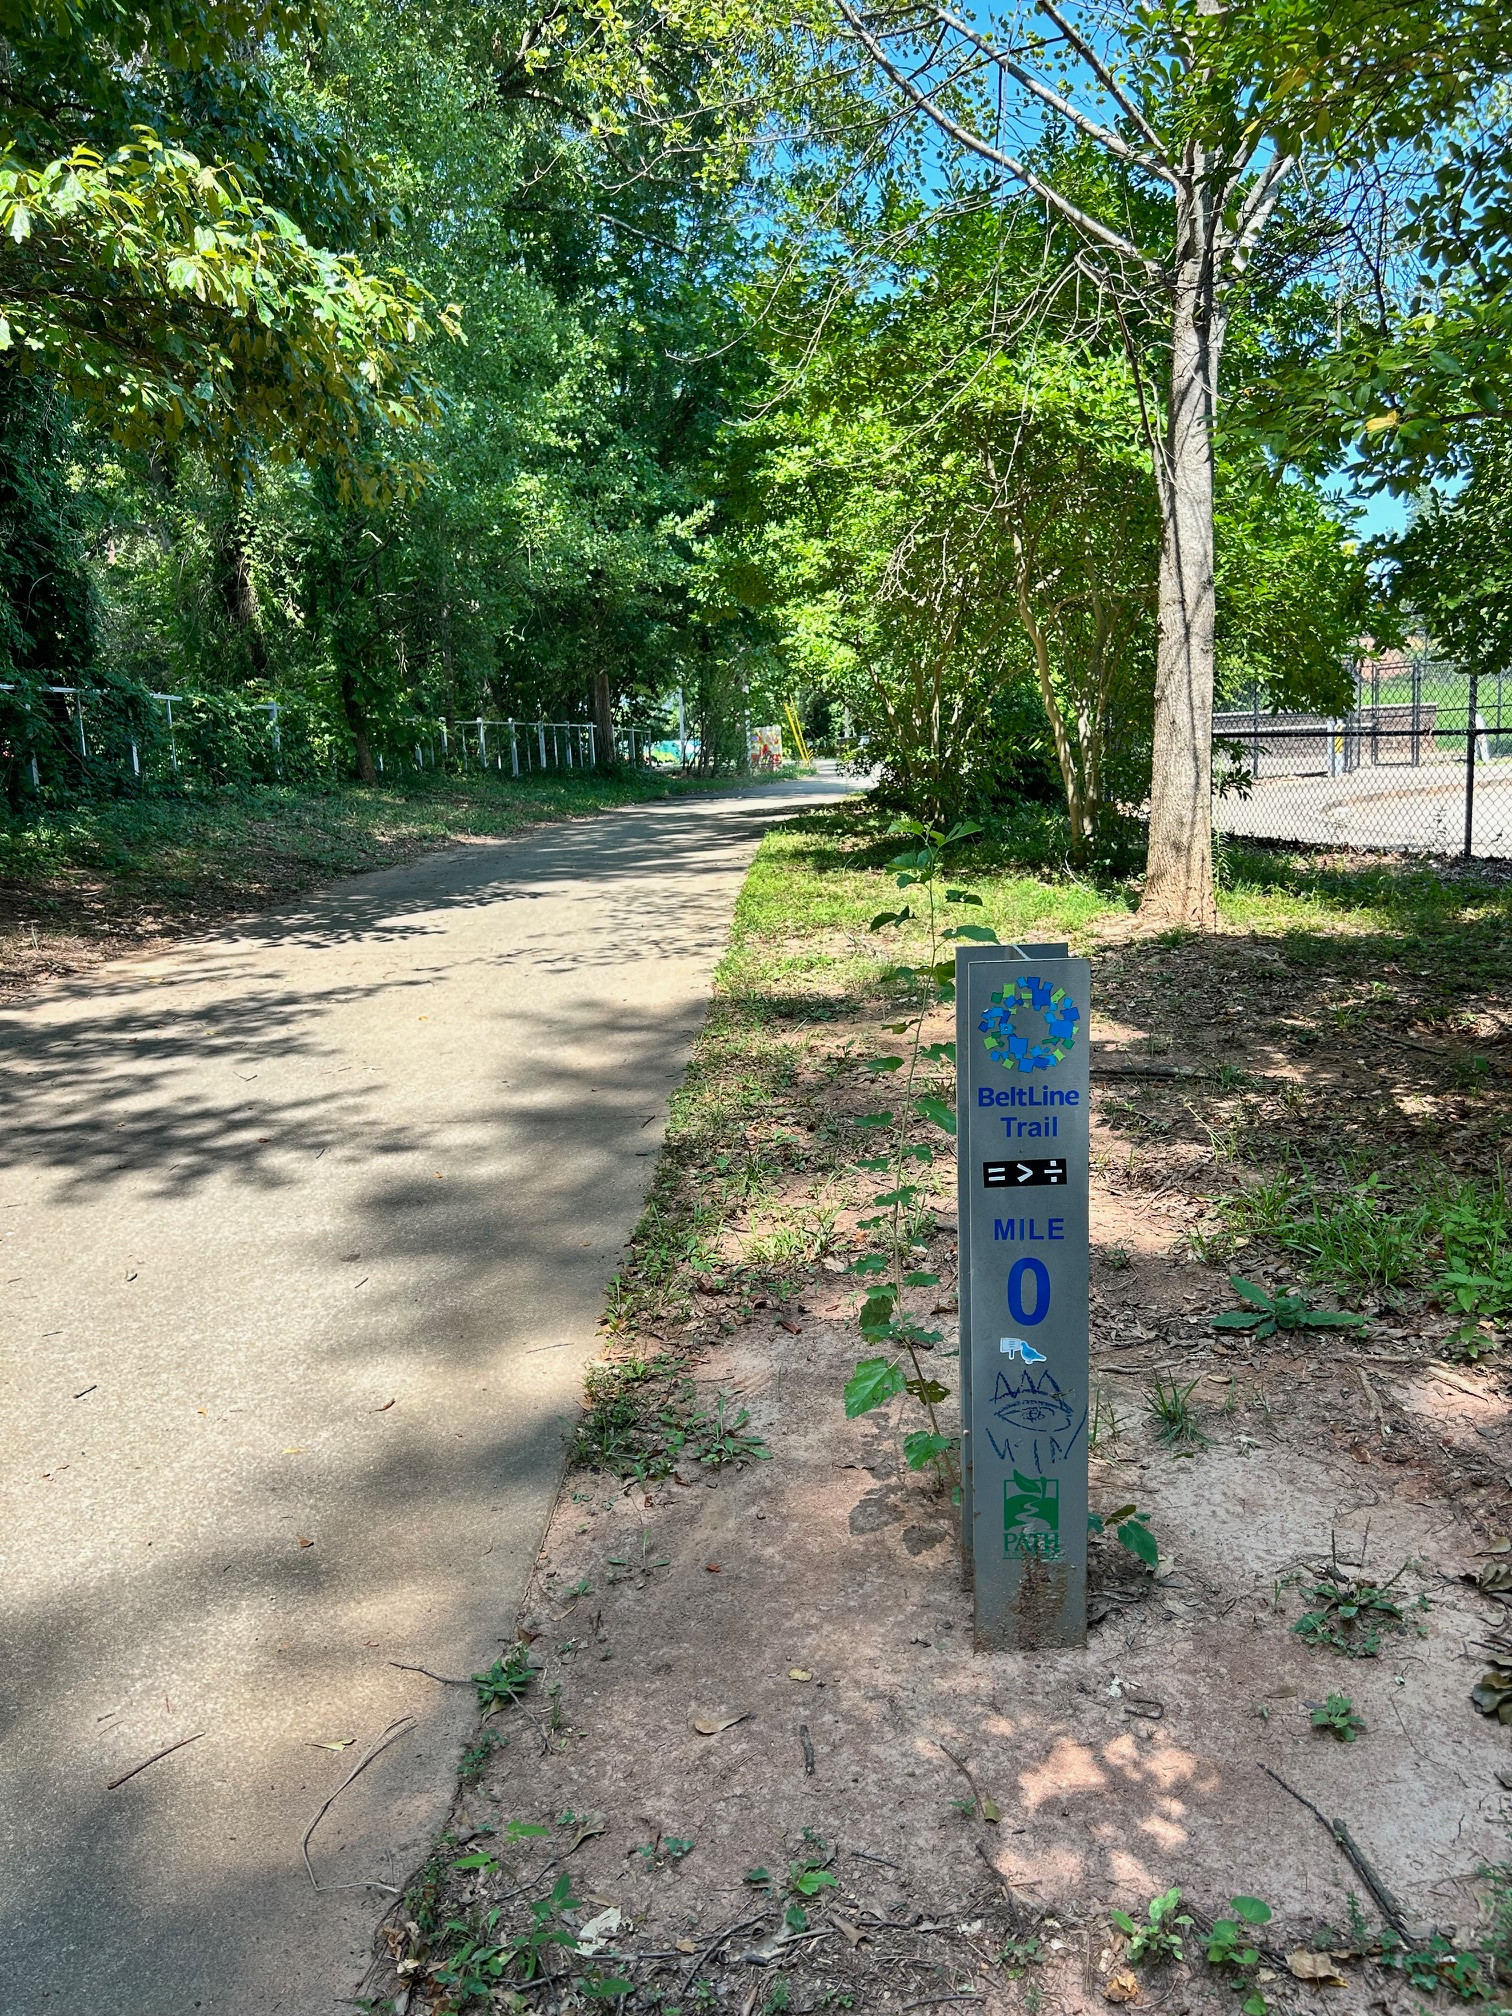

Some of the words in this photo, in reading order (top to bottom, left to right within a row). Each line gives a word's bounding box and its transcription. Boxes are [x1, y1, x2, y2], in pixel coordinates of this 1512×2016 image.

[978, 1085, 1079, 1107] BeltLine
[1000, 1116, 1058, 1138] Trail
[994, 1218, 1065, 1241] MILE
[1007, 1257, 1051, 1327] 0
[1003, 1532, 1060, 1552] PATH
